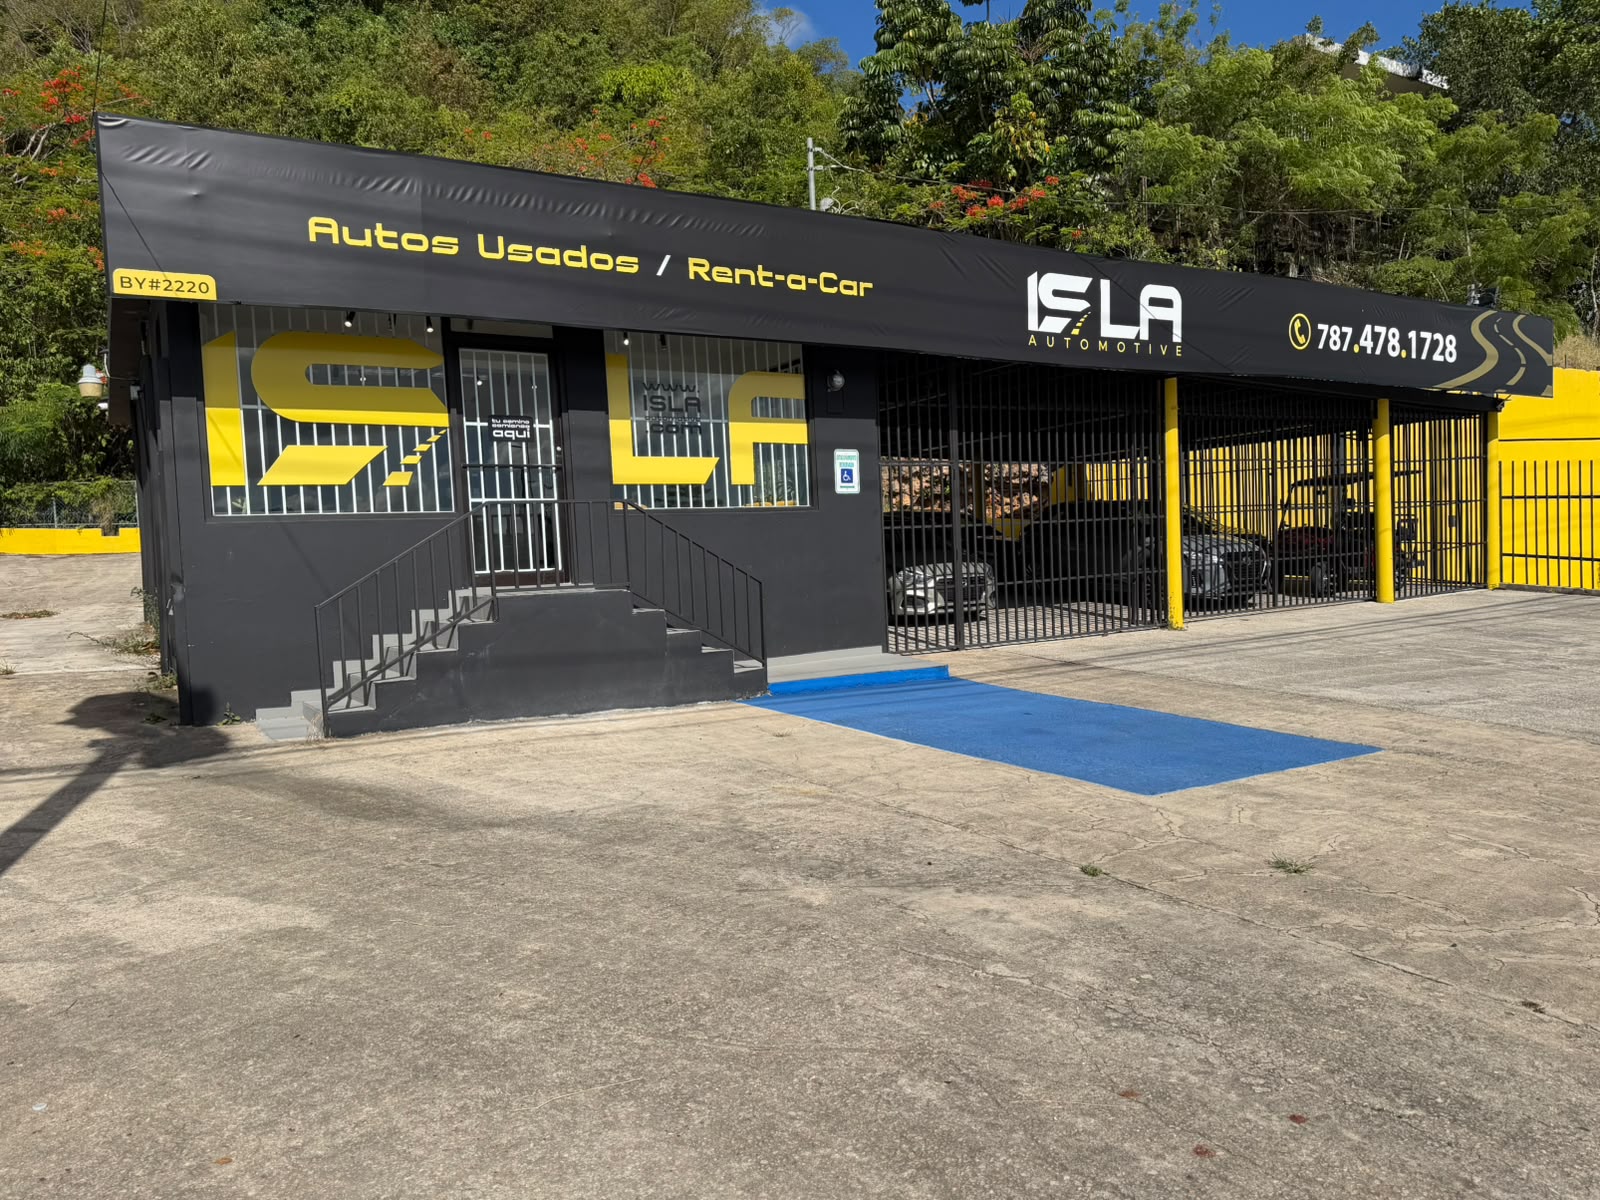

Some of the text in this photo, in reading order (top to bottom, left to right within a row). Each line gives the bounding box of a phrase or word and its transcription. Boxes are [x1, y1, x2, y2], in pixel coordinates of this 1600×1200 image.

[308, 216, 459, 255] Autos
[477, 233, 640, 274] Usados
[687, 256, 874, 297] Rent-a-Car
[119, 276, 210, 294] BY#2220
[1027, 271, 1183, 342] ISLA
[1028, 334, 1183, 357] AUTOMOTIVE
[1317, 322, 1457, 364] 787.478.1728
[642, 382, 700, 393] www.
[643, 394, 701, 413] ISLA
[645, 423, 702, 434] .com
